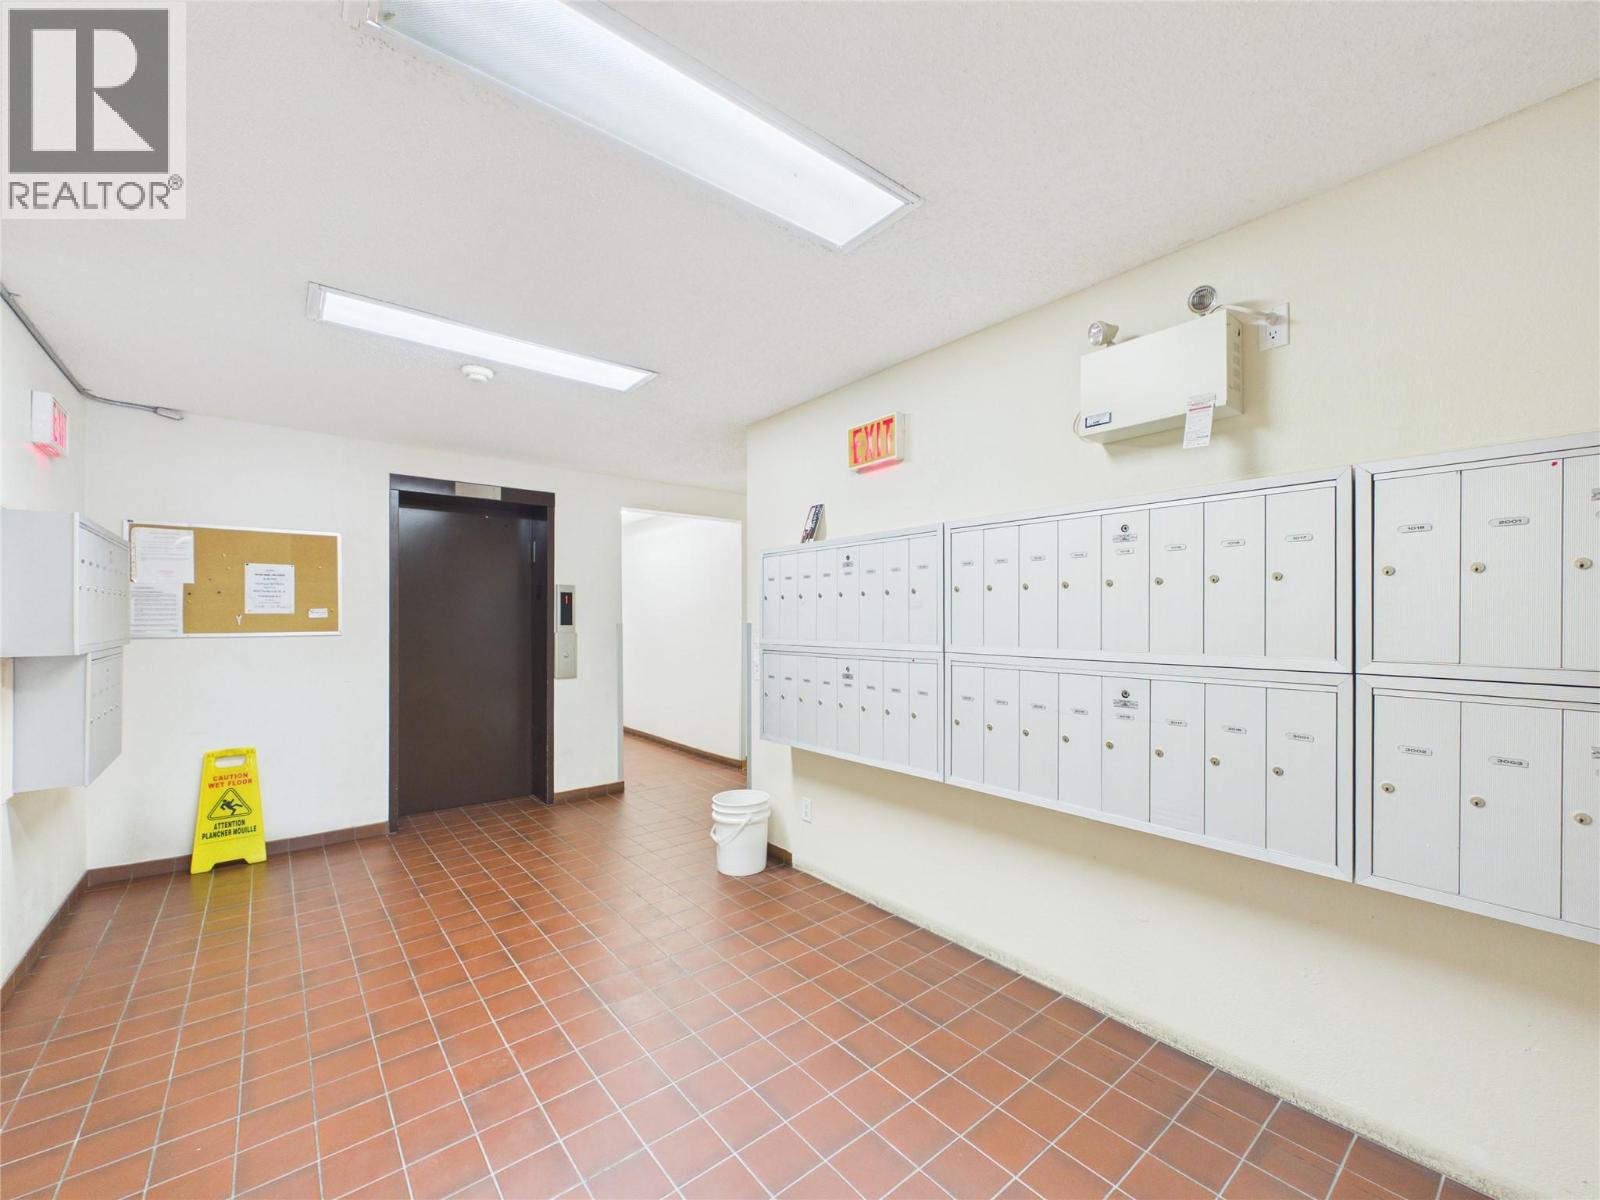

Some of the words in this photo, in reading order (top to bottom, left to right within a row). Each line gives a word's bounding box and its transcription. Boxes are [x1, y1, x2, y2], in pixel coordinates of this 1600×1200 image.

[852, 417, 894, 465] EXIT
[212, 772, 249, 782] CAUTION
[207, 781, 226, 790] WET
[227, 778, 253, 788] FLOOR
[213, 819, 246, 830] ATTENTION
[201, 828, 232, 840] PLANCHER
[233, 825, 257, 836] MOUILLE
